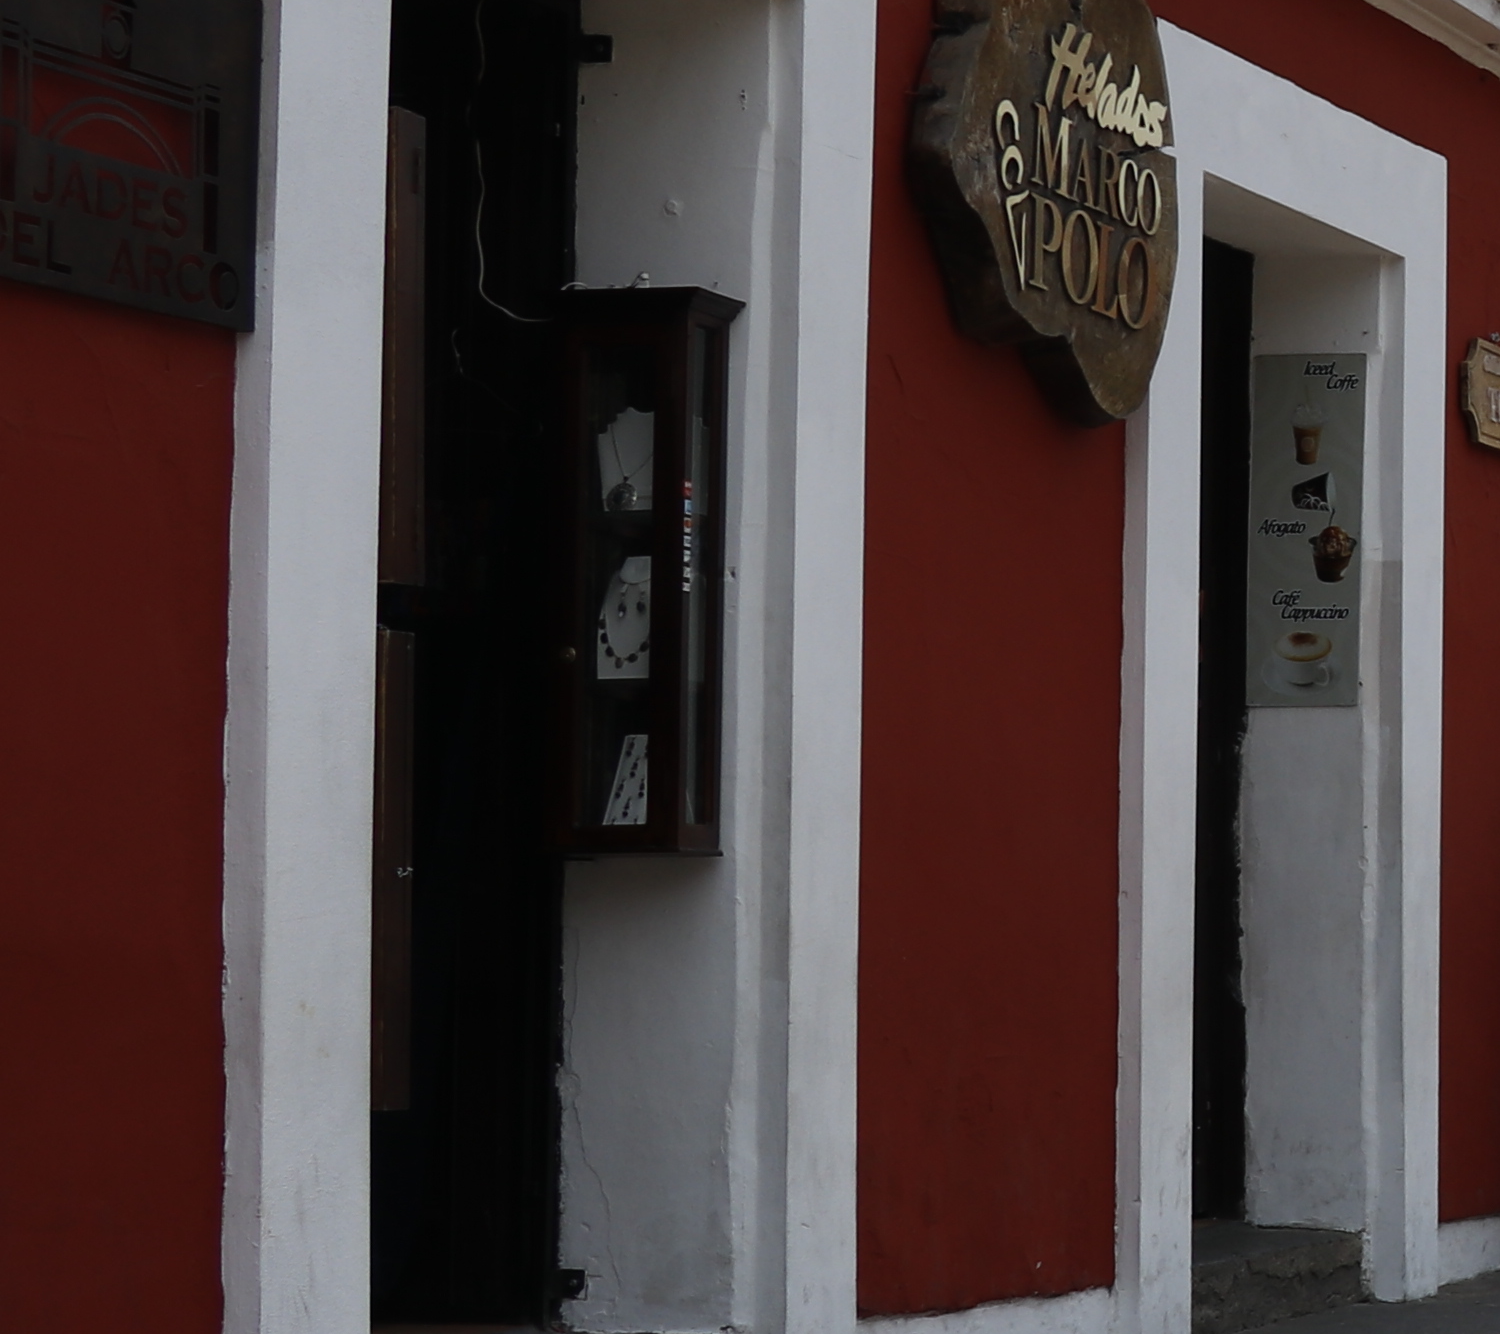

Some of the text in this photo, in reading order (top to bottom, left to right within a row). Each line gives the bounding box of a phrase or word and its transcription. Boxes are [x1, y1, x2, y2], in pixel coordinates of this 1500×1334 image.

[1045, 22, 1167, 147] Helados
[33, 153, 188, 239] JADES
[1031, 102, 1161, 235] MARCO
[0, 208, 240, 310] EL ARCO
[1029, 193, 1158, 329] POLO
[1326, 374, 1359, 392] Coffe
[1257, 519, 1306, 538] Afogato
[1272, 590, 1301, 607] Café
[1281, 604, 1349, 623] Cappuccino
